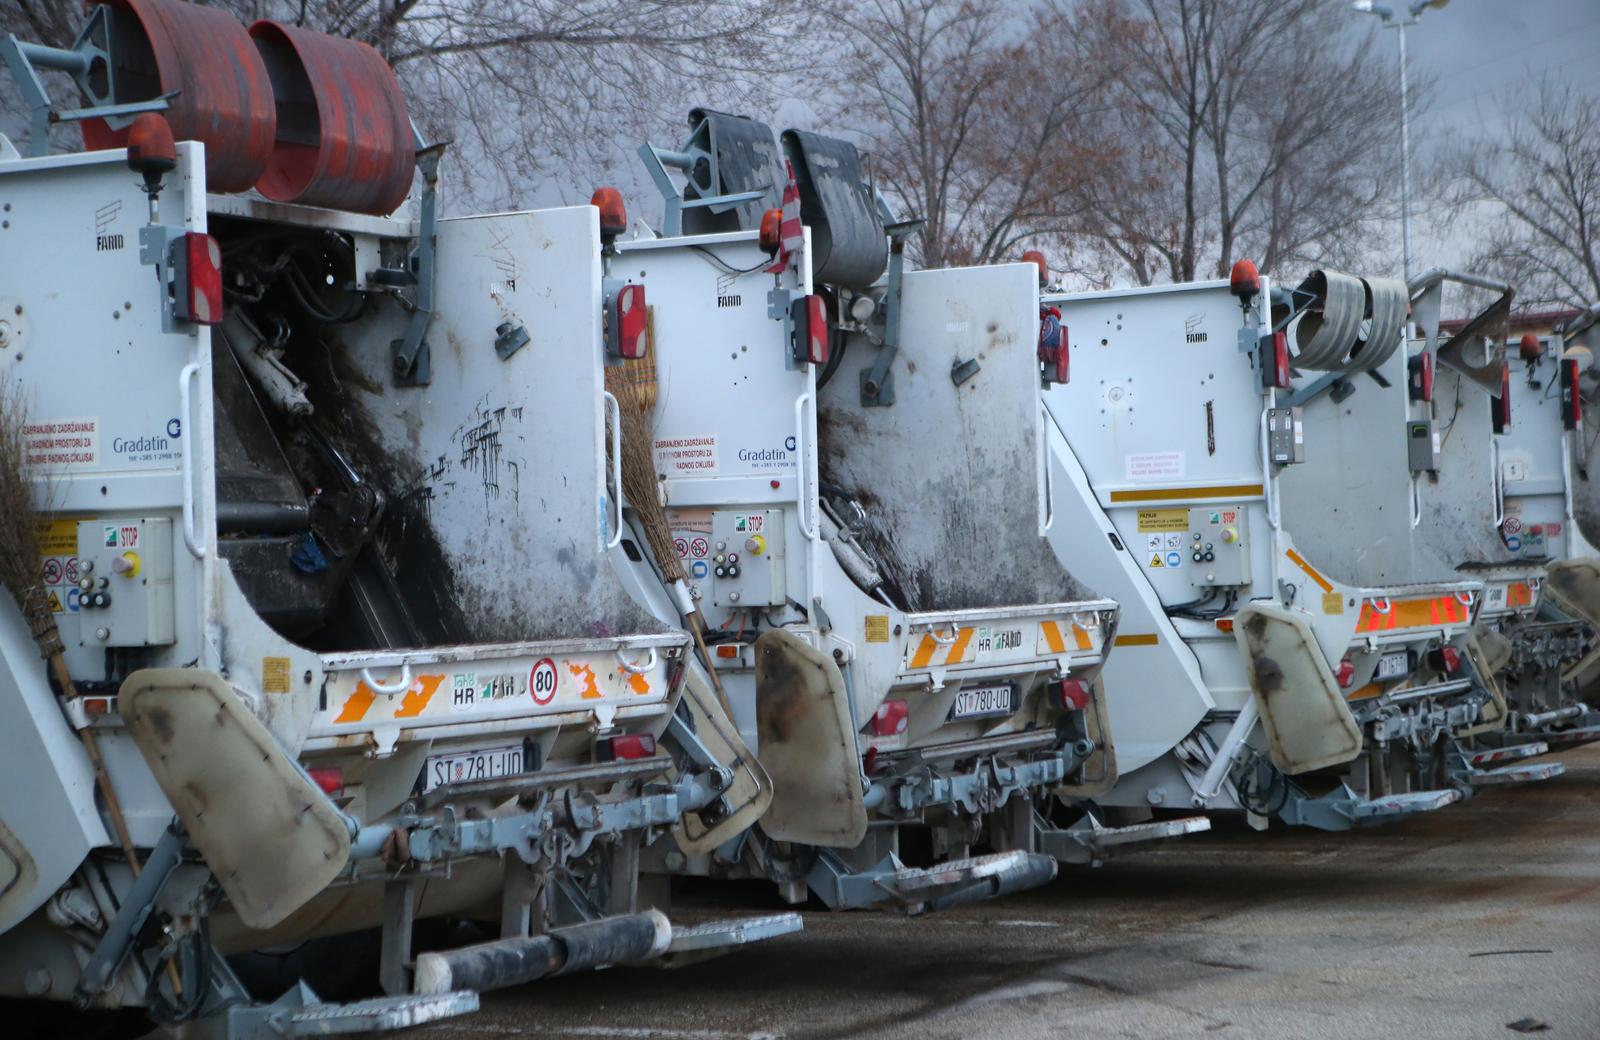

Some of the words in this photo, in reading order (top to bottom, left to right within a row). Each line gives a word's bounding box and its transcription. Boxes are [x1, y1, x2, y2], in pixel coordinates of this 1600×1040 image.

[97, 234, 124, 251] FARID
[717, 295, 742, 308] FARID
[113, 435, 168, 453] Gradatin
[738, 448, 786, 461] Gradatin
[748, 516, 763, 532] STOP
[120, 527, 138, 547] STOP
[978, 638, 991, 652] HR
[536, 670, 553, 692] 80
[454, 688, 474, 705] HR
[957, 692, 969, 713] ST
[434, 760, 454, 786] ST
